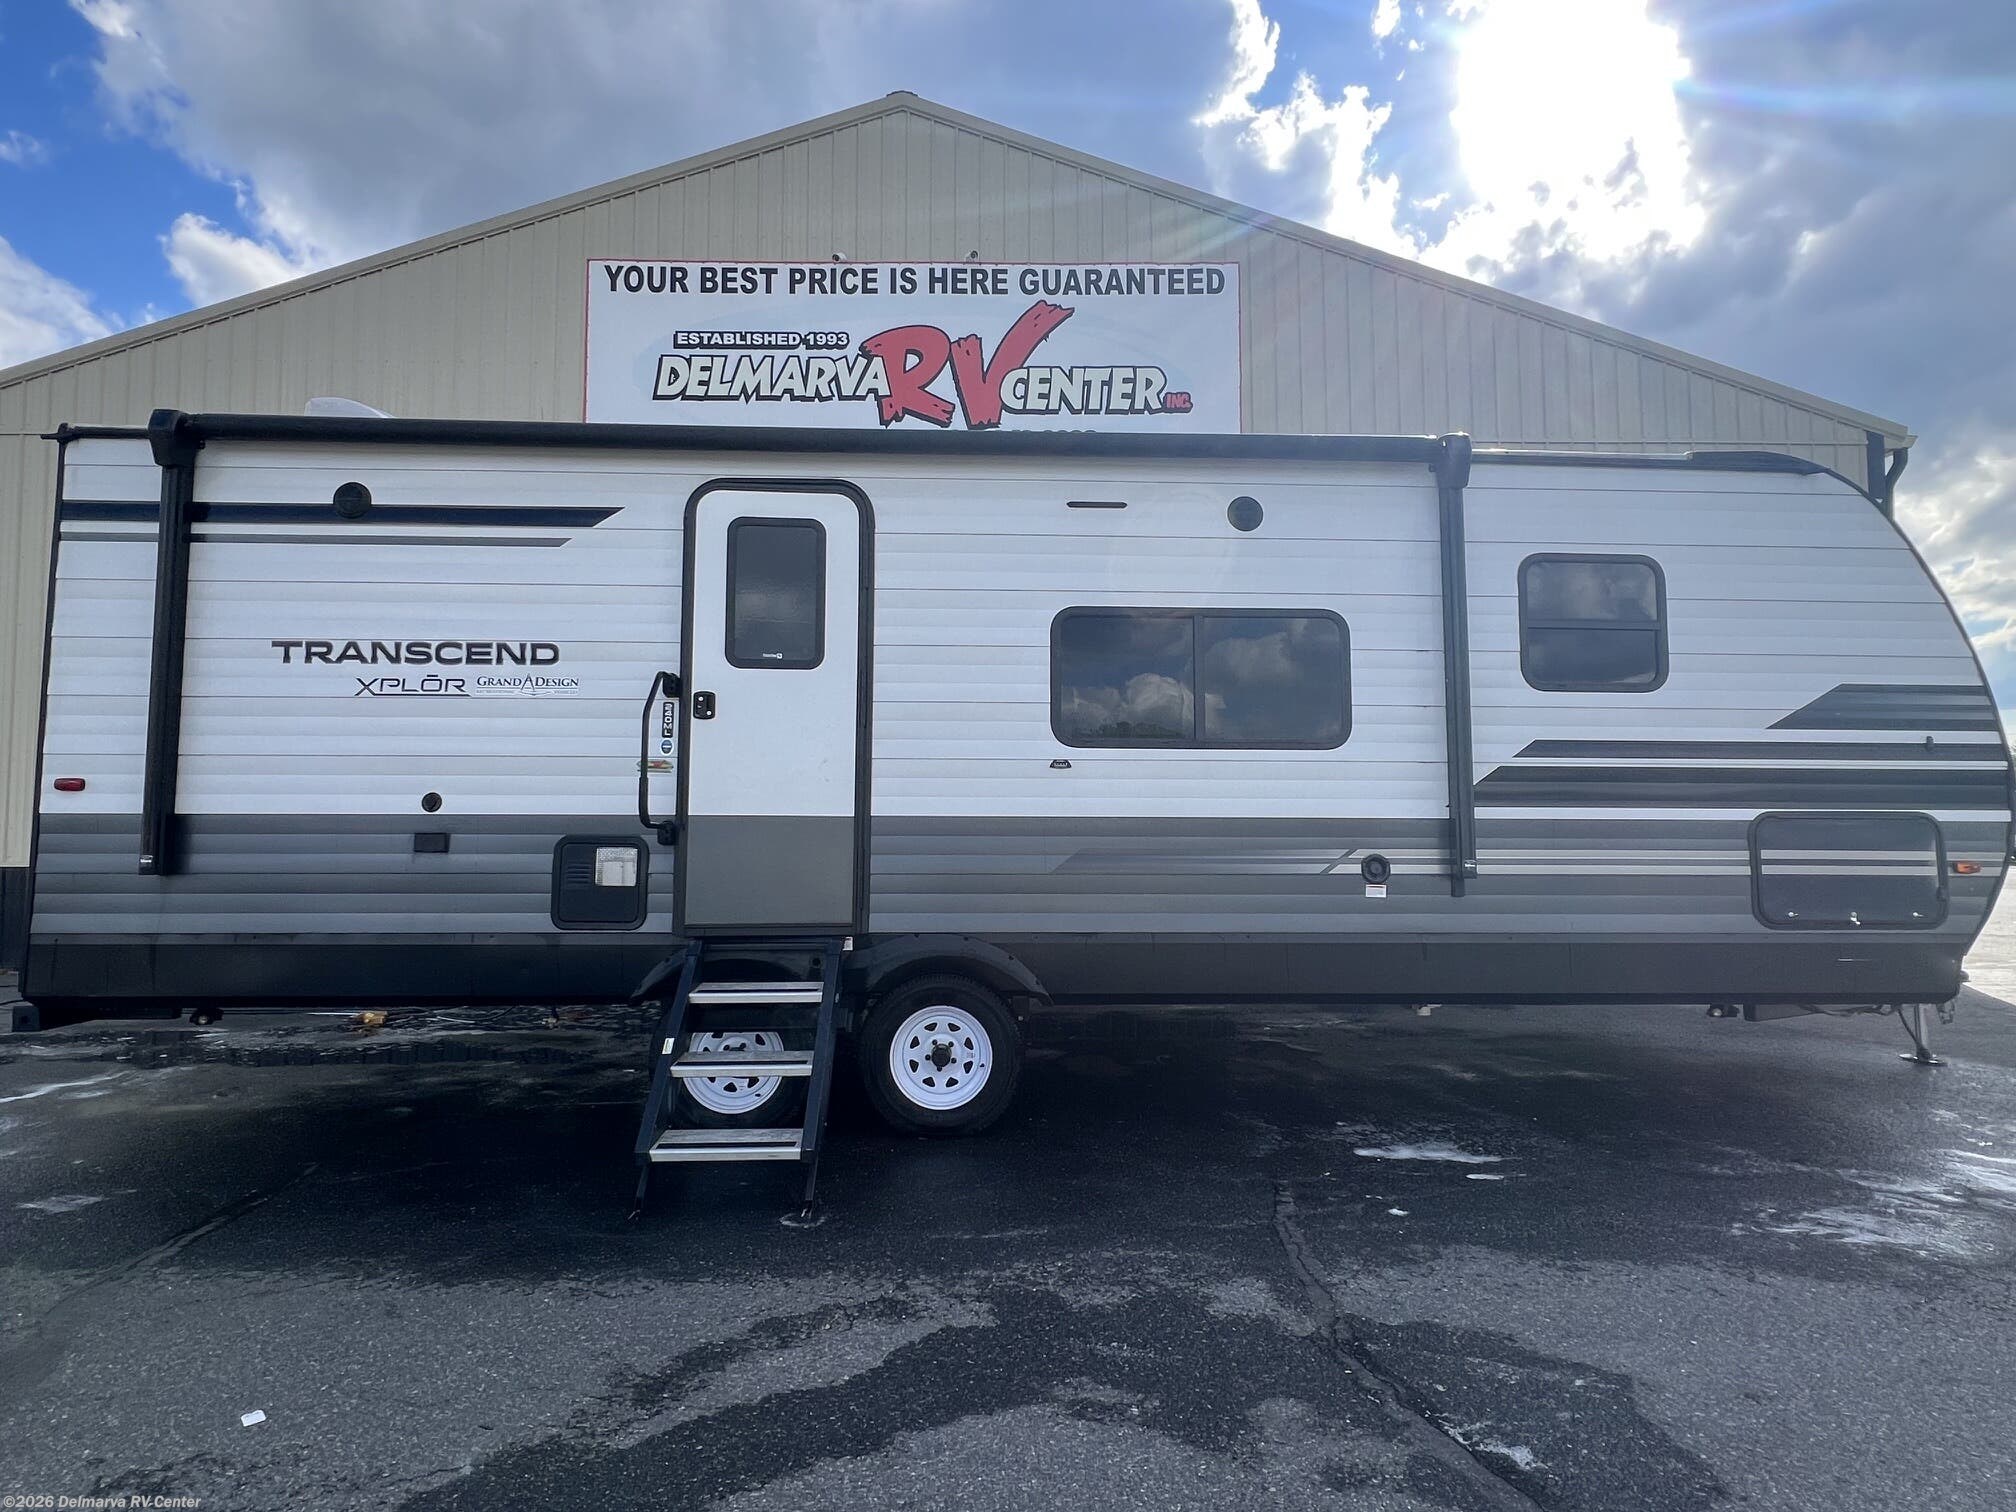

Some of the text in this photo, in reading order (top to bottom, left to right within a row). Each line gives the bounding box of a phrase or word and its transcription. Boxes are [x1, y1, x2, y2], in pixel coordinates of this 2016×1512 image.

[604, 265, 1225, 295] YOUR BEST PRICE IS HERE GUARANTEED
[675, 332, 849, 347] ESTABLISHED 1993
[653, 354, 893, 402] DELMARVA
[859, 300, 1075, 429] RV
[1000, 366, 1167, 414] CENTER
[271, 640, 560, 665] TRANSCEND
[535, 677, 579, 687] DESIGN
